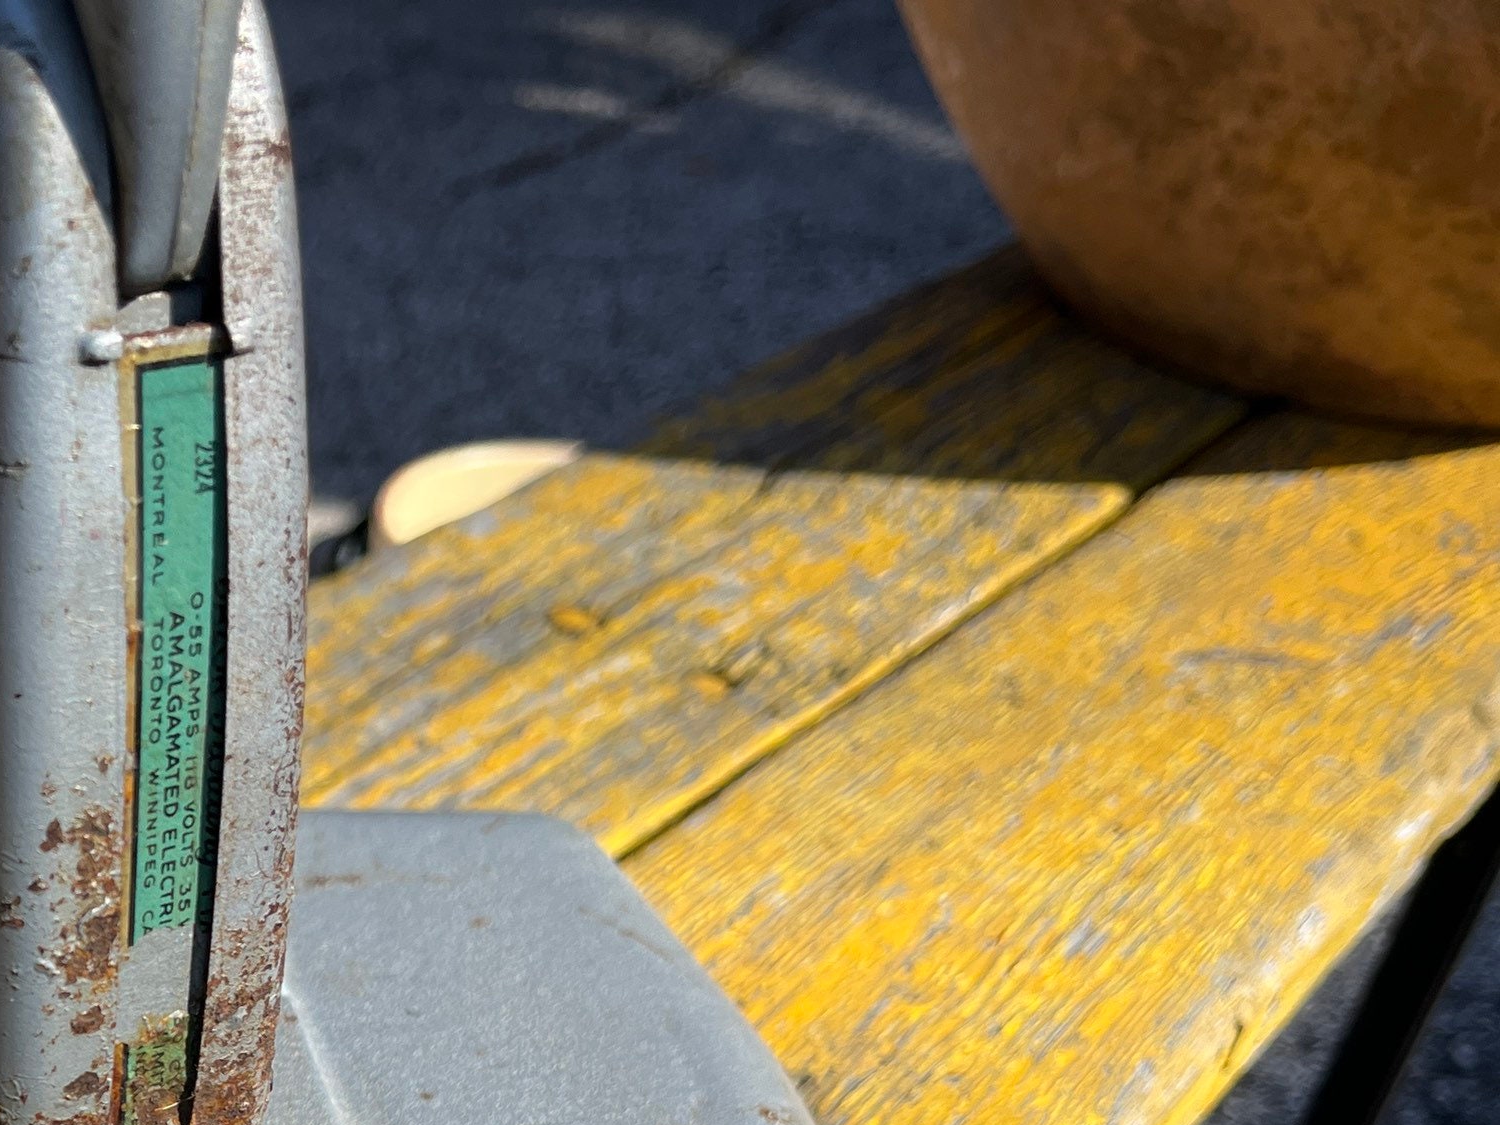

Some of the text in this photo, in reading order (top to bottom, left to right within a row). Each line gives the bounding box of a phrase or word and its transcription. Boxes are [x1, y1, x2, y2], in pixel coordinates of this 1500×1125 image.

[152, 427, 165, 586] MONTREAL
[149, 617, 164, 744] TORONTO
[163, 611, 185, 818] AMALGAMATED
[143, 770, 161, 889] WINNIPEG
[160, 828, 177, 928] ELECTRI
[180, 800, 196, 868] VOLTS
[178, 883, 192, 912] 35
